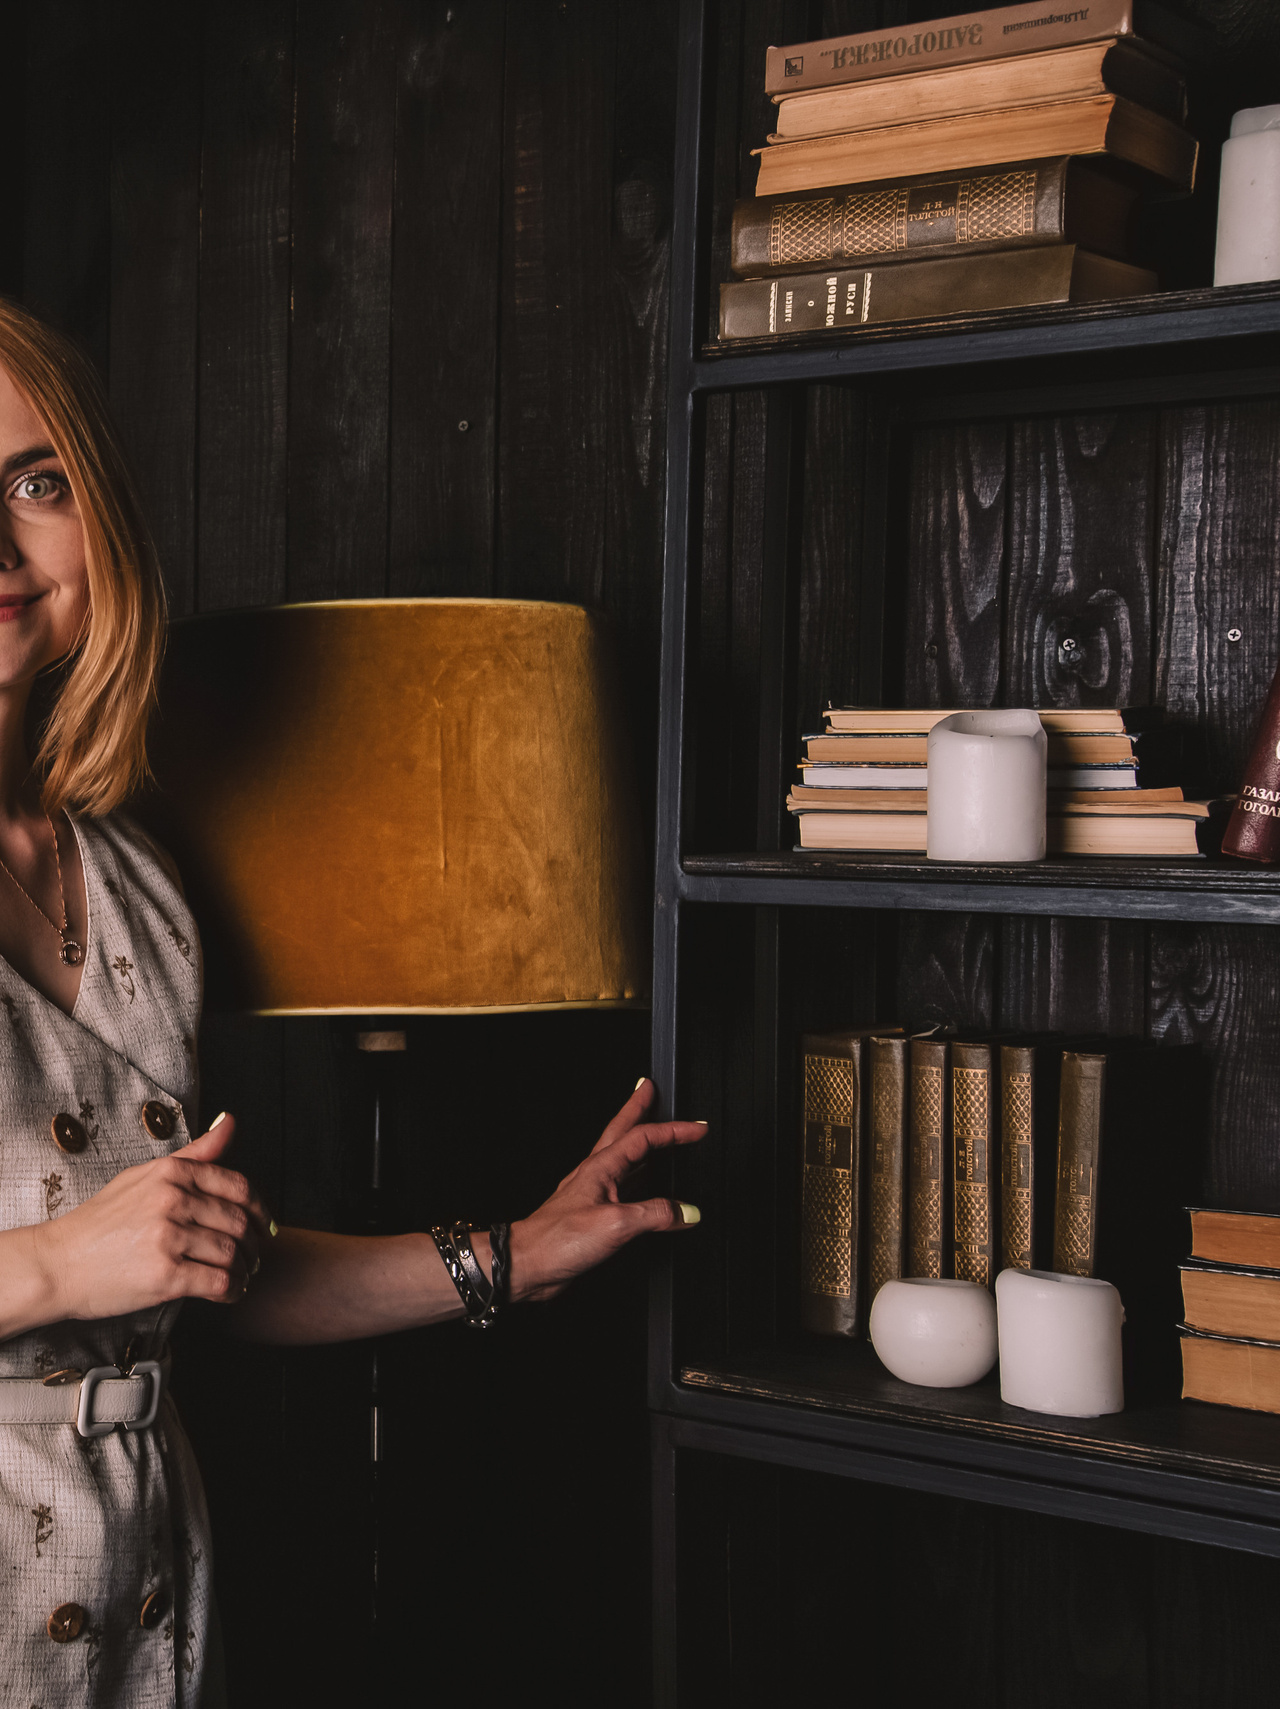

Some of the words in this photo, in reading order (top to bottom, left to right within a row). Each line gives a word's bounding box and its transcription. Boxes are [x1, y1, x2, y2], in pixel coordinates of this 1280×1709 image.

[908, 206, 957, 222] ТОЛСТОЙ
[784, 291, 794, 323] ЗАПИСКИ
[825, 276, 838, 327] ЮЖНОЙ
[846, 283, 857, 315] РУСИ
[965, 1138, 973, 1181] ТОЛСТОЙ
